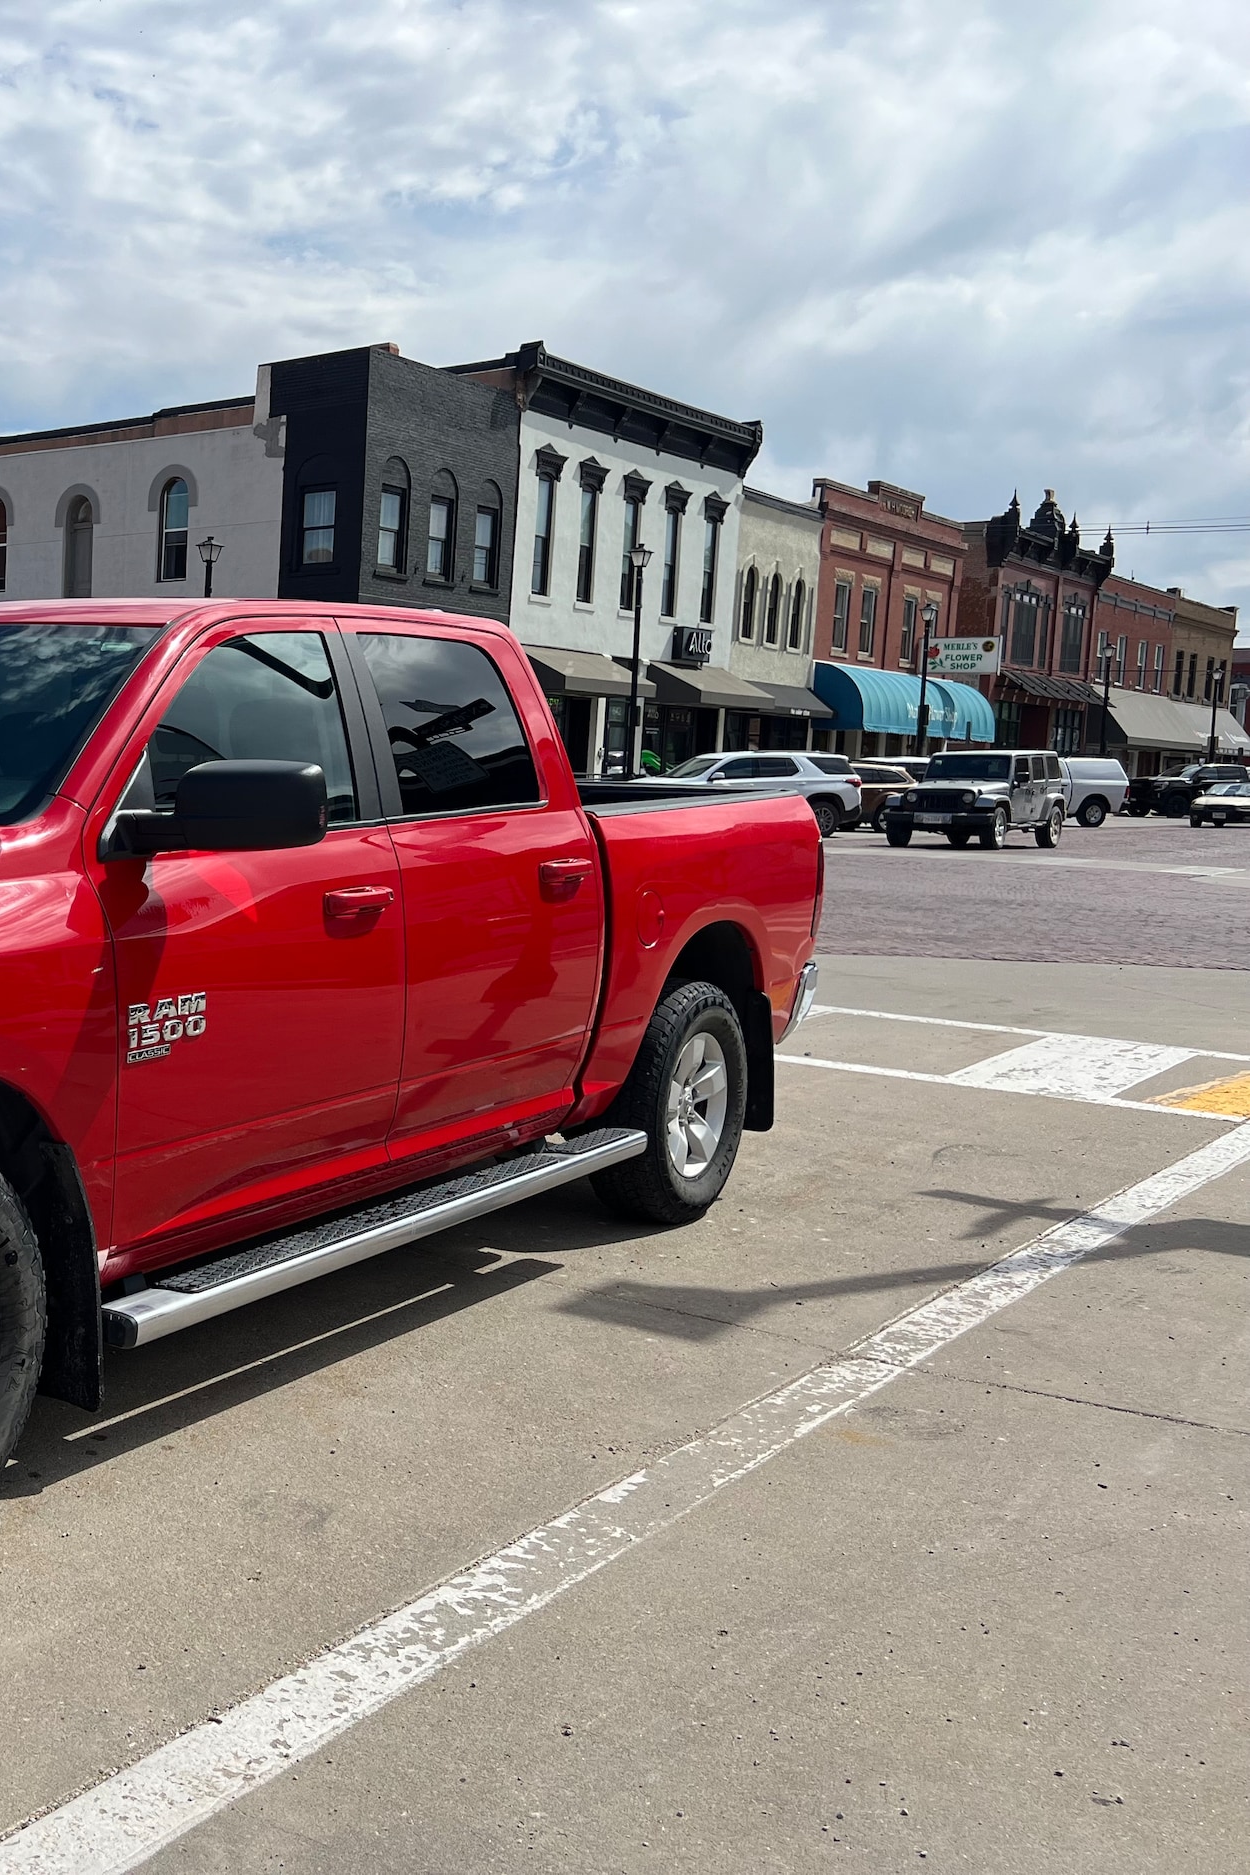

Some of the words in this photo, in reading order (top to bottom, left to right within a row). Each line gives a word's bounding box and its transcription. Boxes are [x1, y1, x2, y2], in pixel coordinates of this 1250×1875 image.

[943, 642, 978, 651] MERLE'S
[945, 653, 983, 662] FLOWER
[950, 662, 977, 670] SHOP
[128, 991, 206, 1025] RAM
[128, 1015, 206, 1049] 1500
[129, 1045, 170, 1061] CLASSIC
